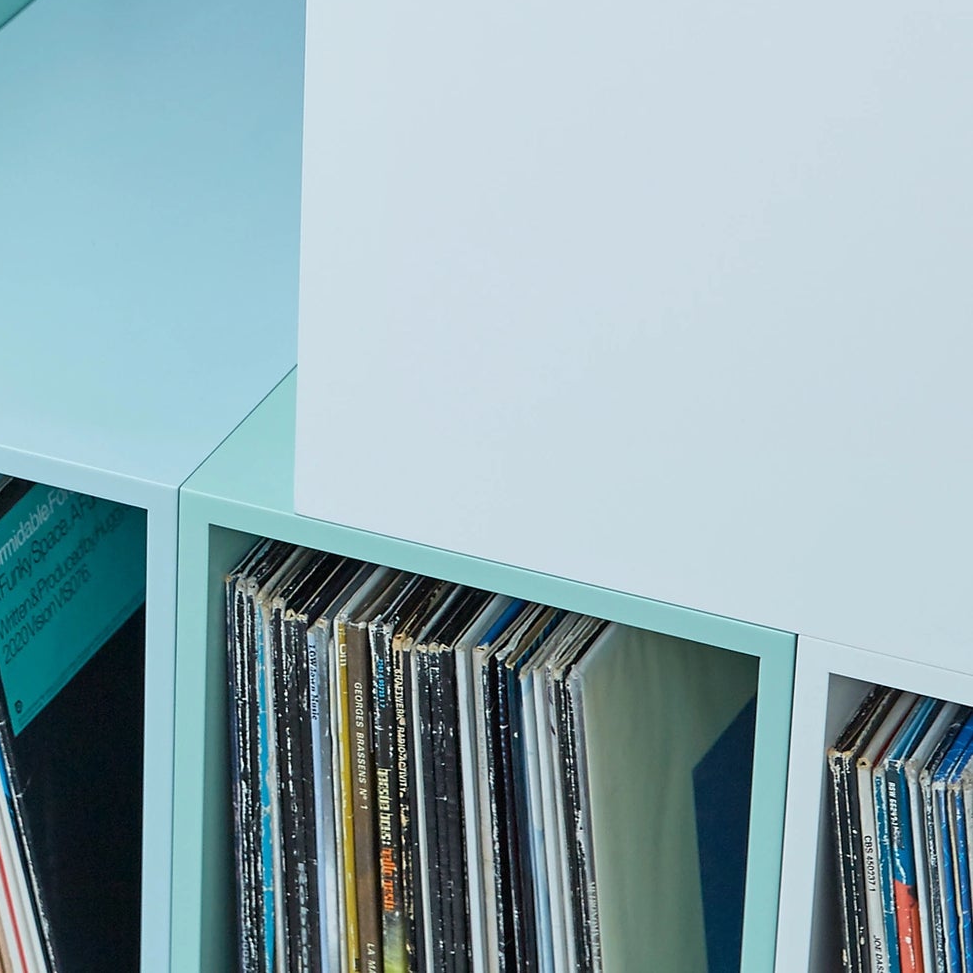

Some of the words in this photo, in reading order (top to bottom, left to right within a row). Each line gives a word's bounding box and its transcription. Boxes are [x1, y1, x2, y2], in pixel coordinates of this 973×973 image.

[354, 682, 365, 728] GEORGES
[355, 731, 367, 784] BRASSENS
[864, 835, 873, 854] CBS
[875, 952, 885, 973] DAS
